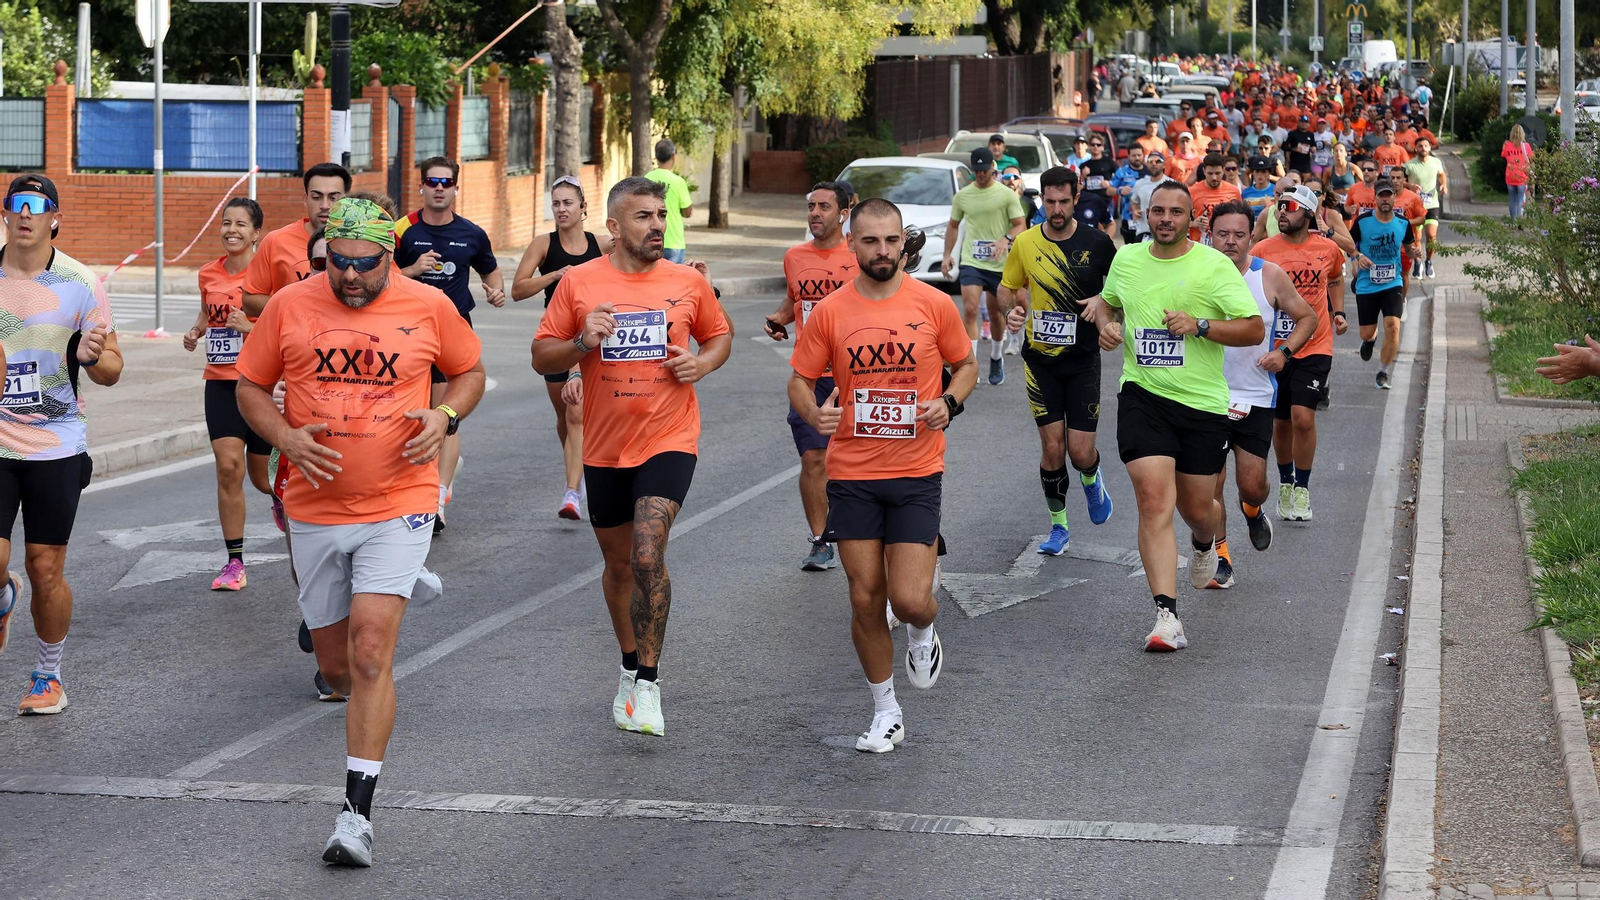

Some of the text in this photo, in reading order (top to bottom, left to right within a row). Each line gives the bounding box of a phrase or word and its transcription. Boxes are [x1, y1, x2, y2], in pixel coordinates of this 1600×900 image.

[1285, 269, 1322, 284] XIX
[1376, 270, 1390, 278] 857
[1043, 321, 1066, 334] 767
[616, 328, 651, 345] 964
[210, 340, 231, 352] 795
[1141, 341, 1177, 355] 1017
[847, 342, 917, 369] XXIX
[314, 348, 400, 379] XXIX
[316, 375, 341, 383] MEDIA
[343, 377, 384, 386] MARATÓN
[869, 405, 902, 422] 453
[334, 431, 377, 439] SPORTMADNESS
